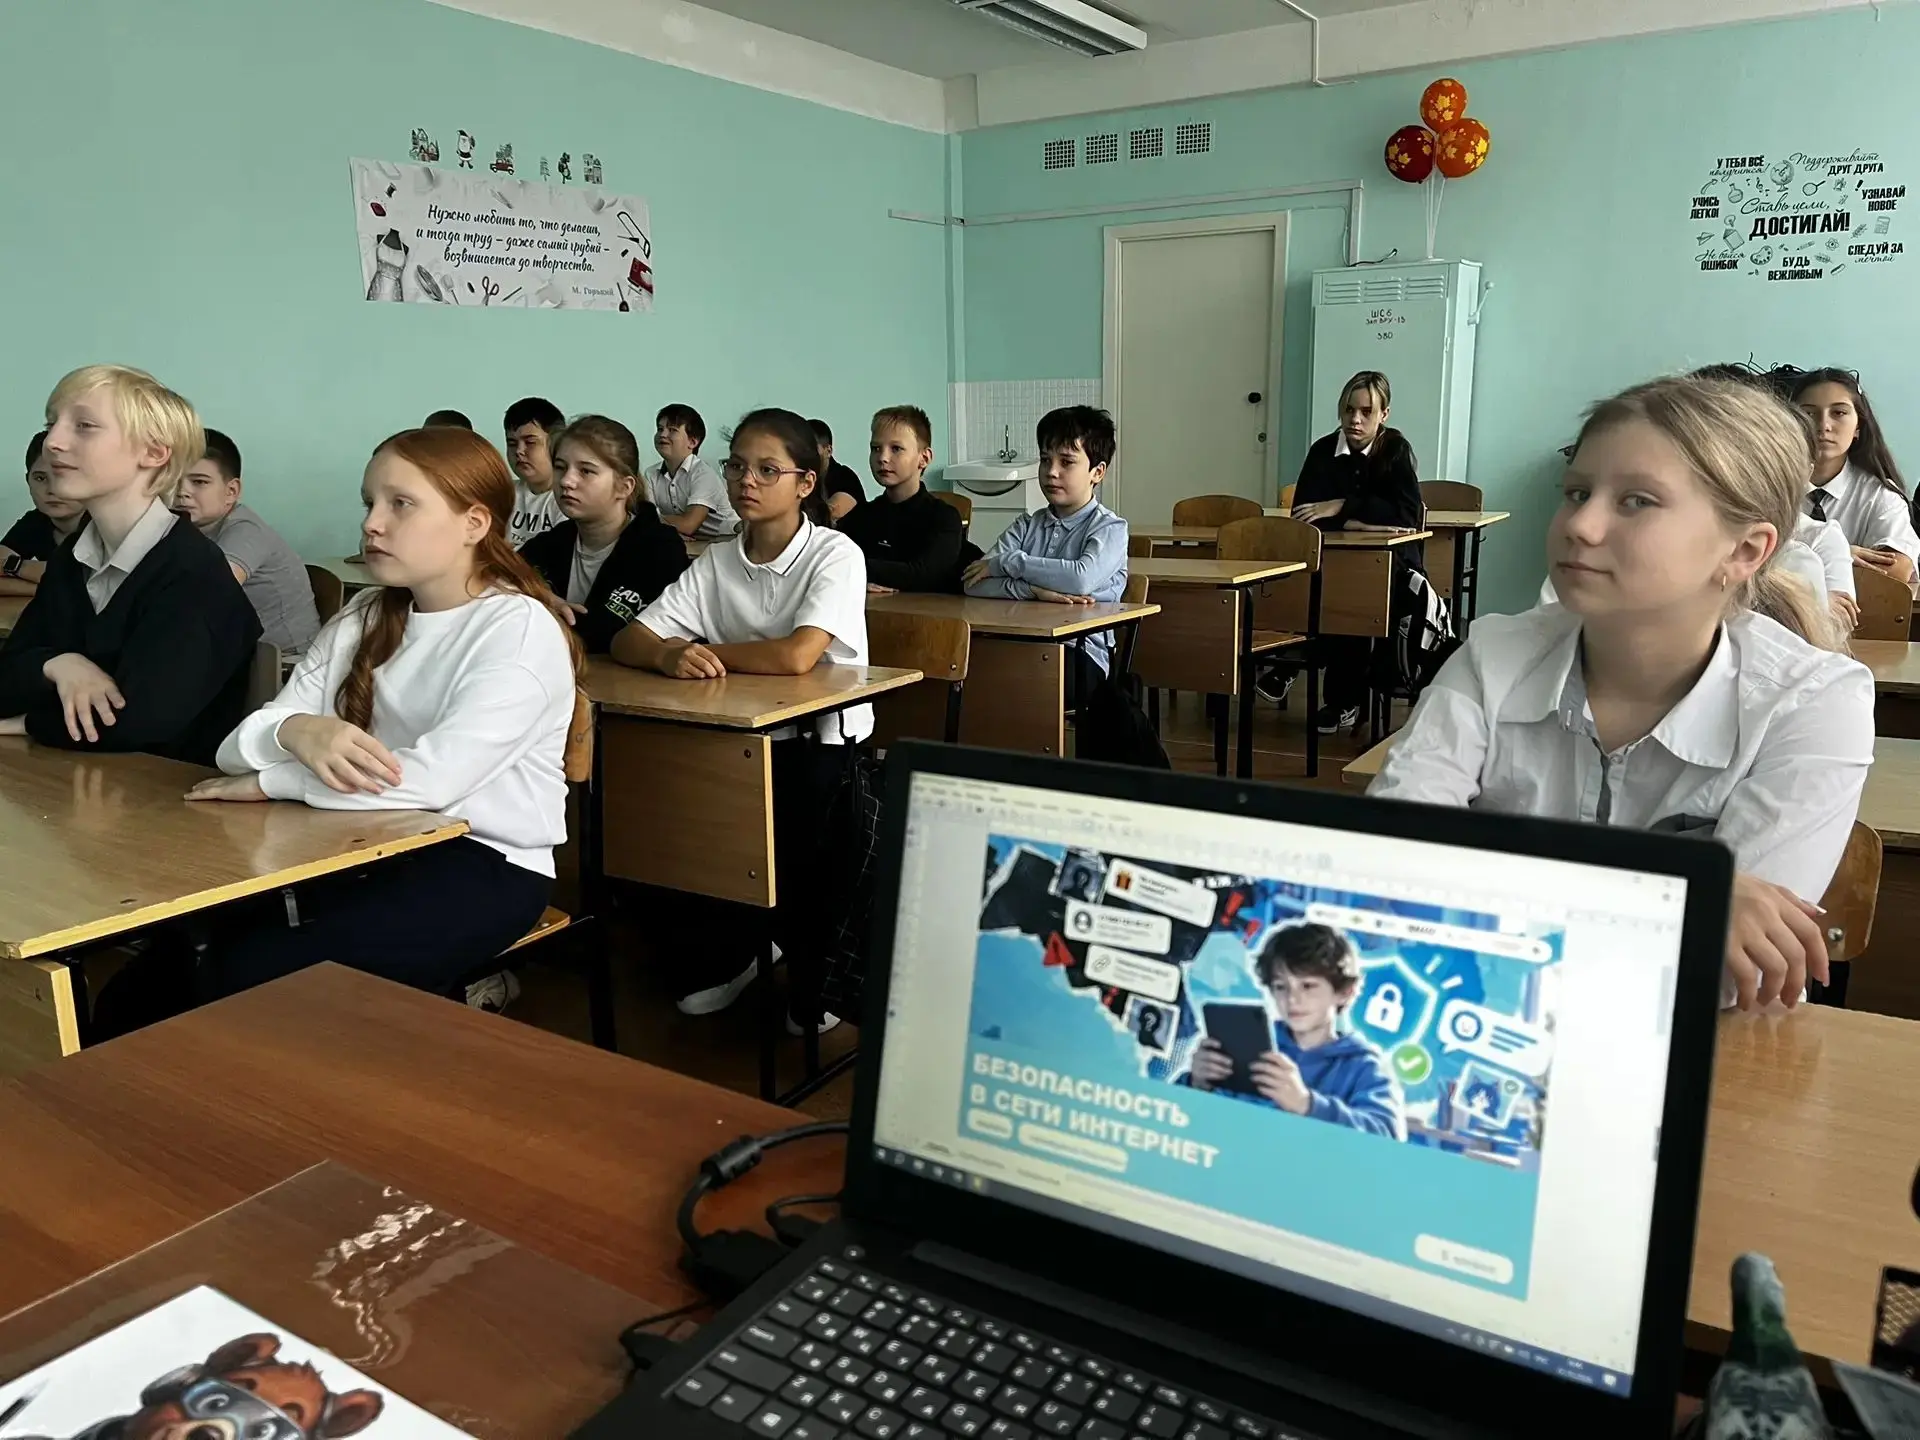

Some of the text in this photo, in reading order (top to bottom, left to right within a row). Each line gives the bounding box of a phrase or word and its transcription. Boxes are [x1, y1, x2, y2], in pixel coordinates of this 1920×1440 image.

[1717, 158, 1723, 169] У
[1725, 157, 1746, 168] ТЕБЯ
[1827, 162, 1884, 176] ДРУГ ДРУГА
[1861, 185, 1906, 200] УЗНАВАЙ
[1692, 196, 1720, 208] УЧИСЬ
[1740, 192, 1830, 214] Ставь цели,
[1867, 200, 1897, 212] НОВОЕ
[427, 204, 601, 237] Нужно любить то, что делаешь,
[1748, 209, 1851, 241] ДОСТИГАЙ!
[416, 228, 424, 238] и
[426, 229, 460, 245] тогда
[463, 232, 492, 249] труд
[505, 236, 534, 251] даже
[537, 238, 568, 251] самый
[570, 238, 602, 258] грубый
[1847, 241, 1904, 257] СЛЕДУЙ ЗА
[443, 246, 595, 274] возвышается до творчества.
[1694, 249, 1716, 262] Не
[1782, 256, 1810, 269] БУДЬ
[1700, 259, 1739, 271] ОШИБОК
[1767, 268, 1823, 281] ВЕЖЛИВЫМ
[972, 1052, 1191, 1128] БЕЗОПАСНОСТЬ
[970, 1083, 988, 1104] В
[993, 1088, 1063, 1127] СЕТИ
[1068, 1108, 1220, 1169] ИНТЕРНЕТ
